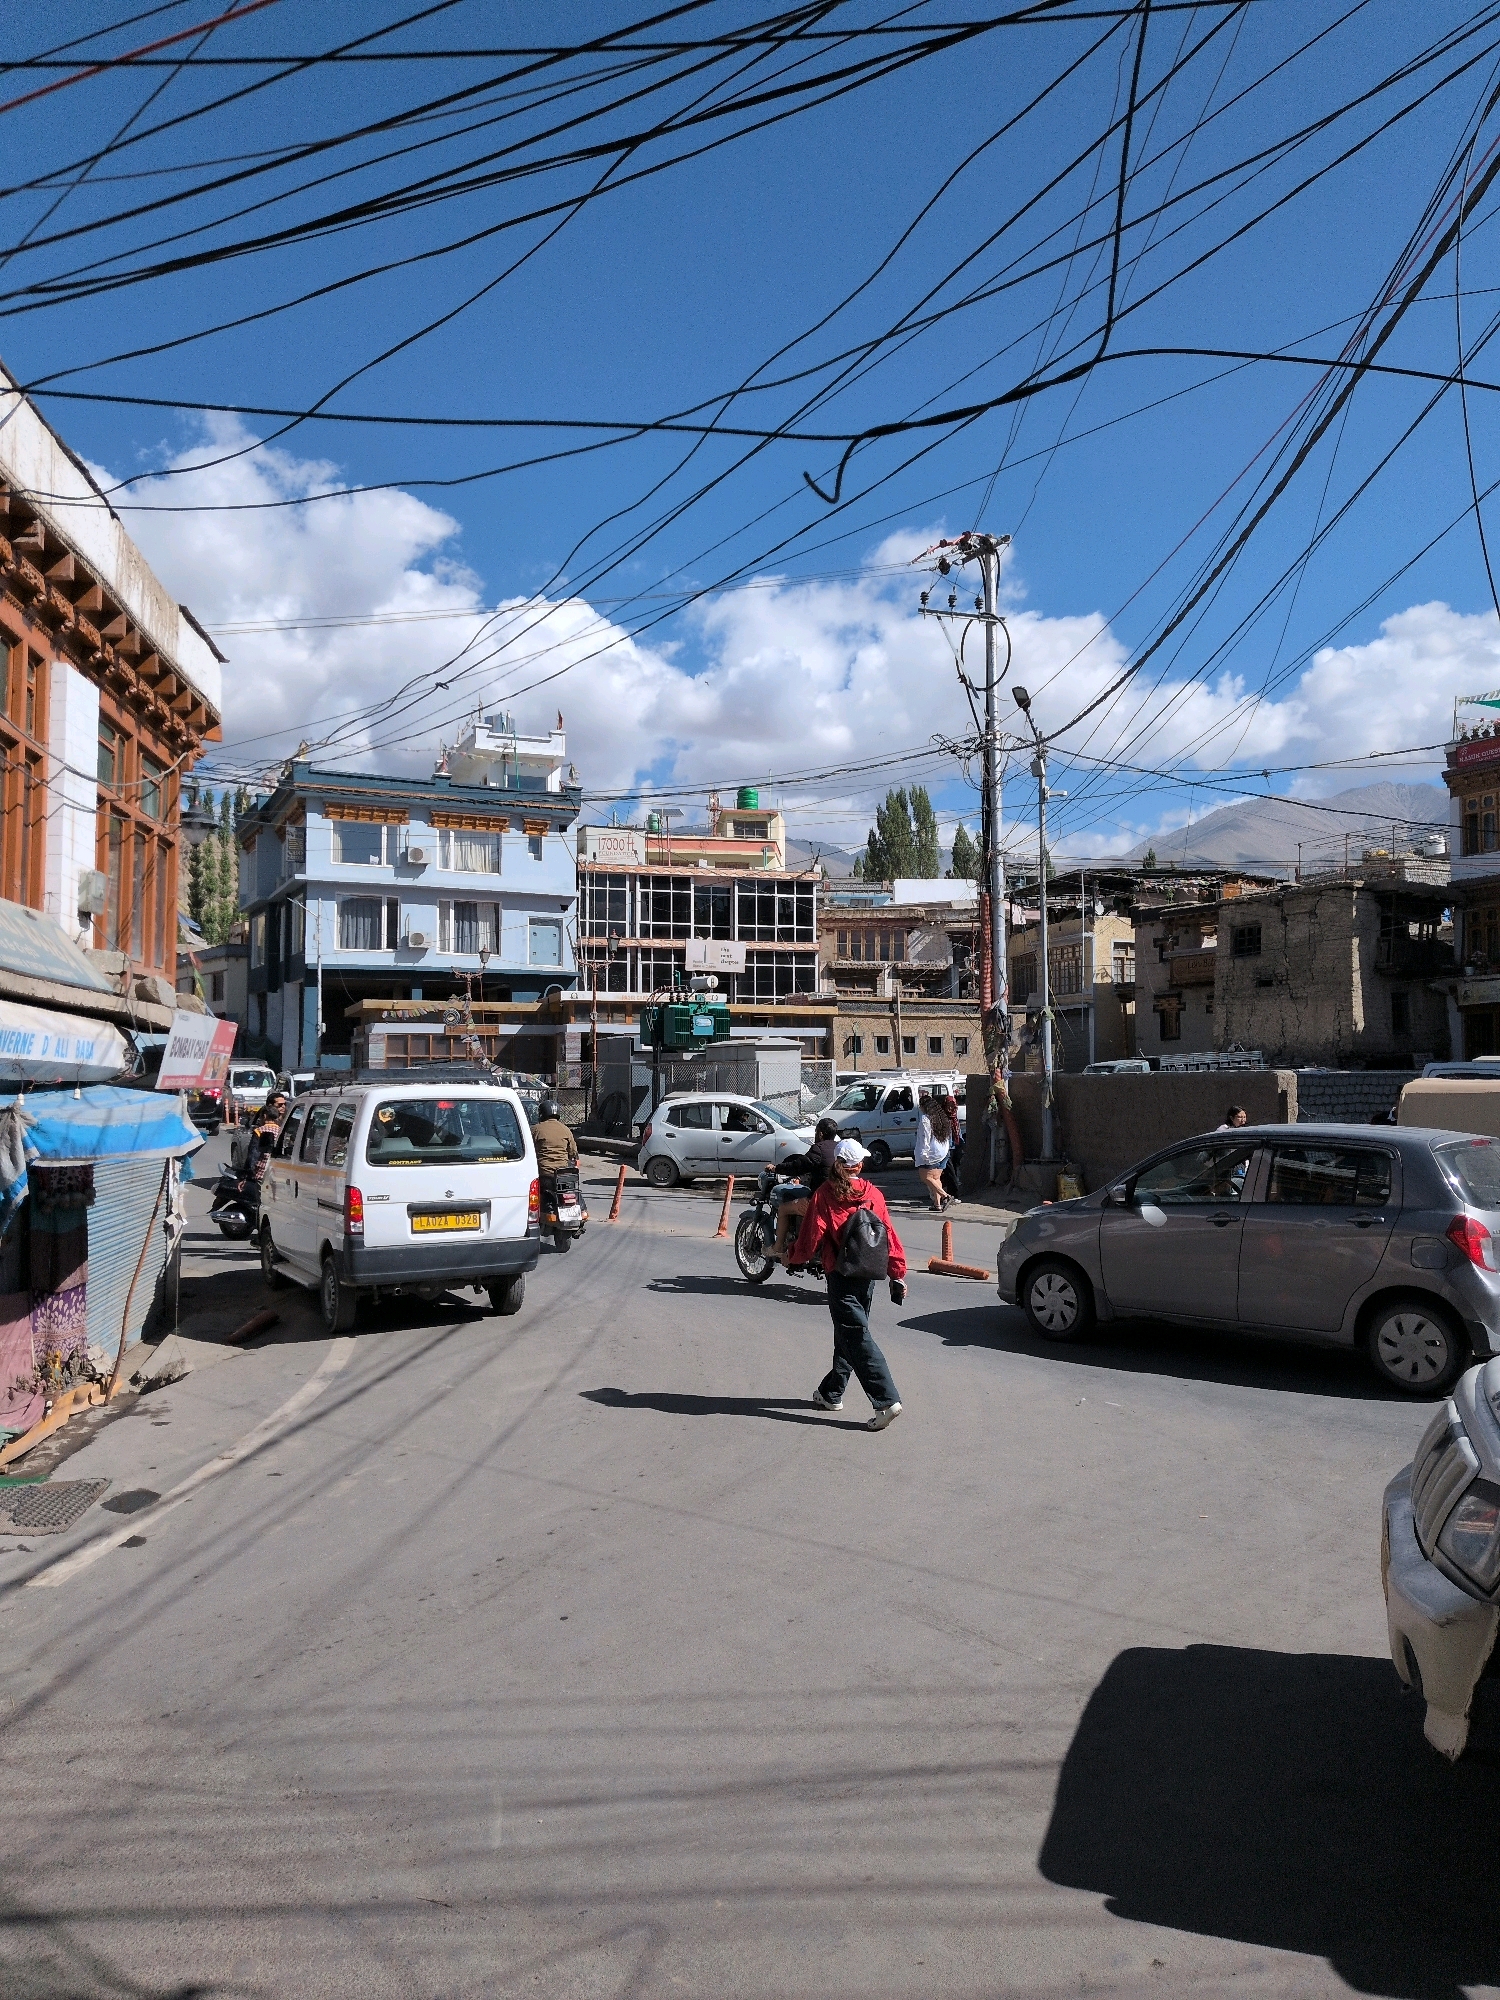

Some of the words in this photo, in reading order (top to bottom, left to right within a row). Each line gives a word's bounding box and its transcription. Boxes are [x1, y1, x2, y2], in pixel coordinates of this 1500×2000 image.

[598, 836, 625, 851] 17000
[54, 1037, 70, 1058] ALI
[75, 1039, 95, 1060] BABA
[169, 1035, 196, 1058] BOMBAY
